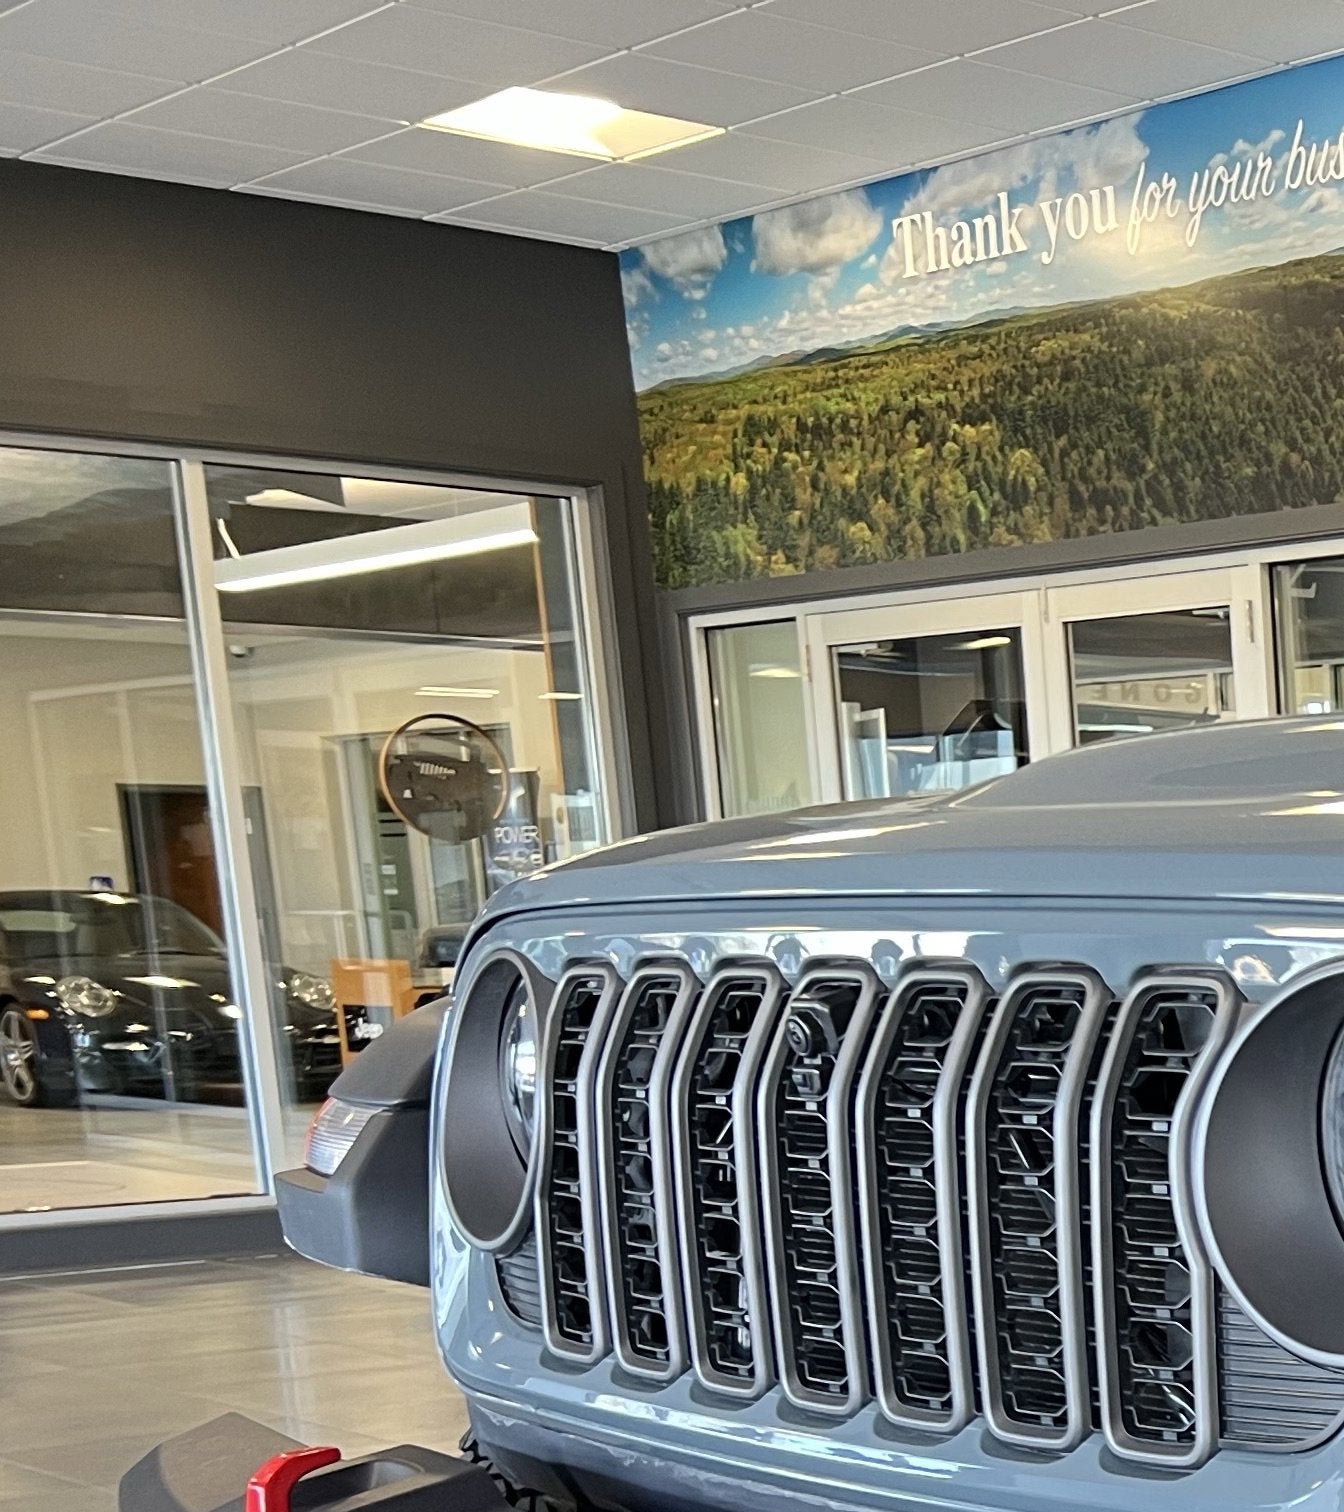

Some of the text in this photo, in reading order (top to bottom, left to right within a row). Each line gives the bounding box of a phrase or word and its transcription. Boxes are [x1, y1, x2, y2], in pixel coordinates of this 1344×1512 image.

[892, 193, 1028, 279] Thank
[1039, 184, 1118, 264] you
[1127, 161, 1177, 255] for
[1189, 155, 1276, 248] your
